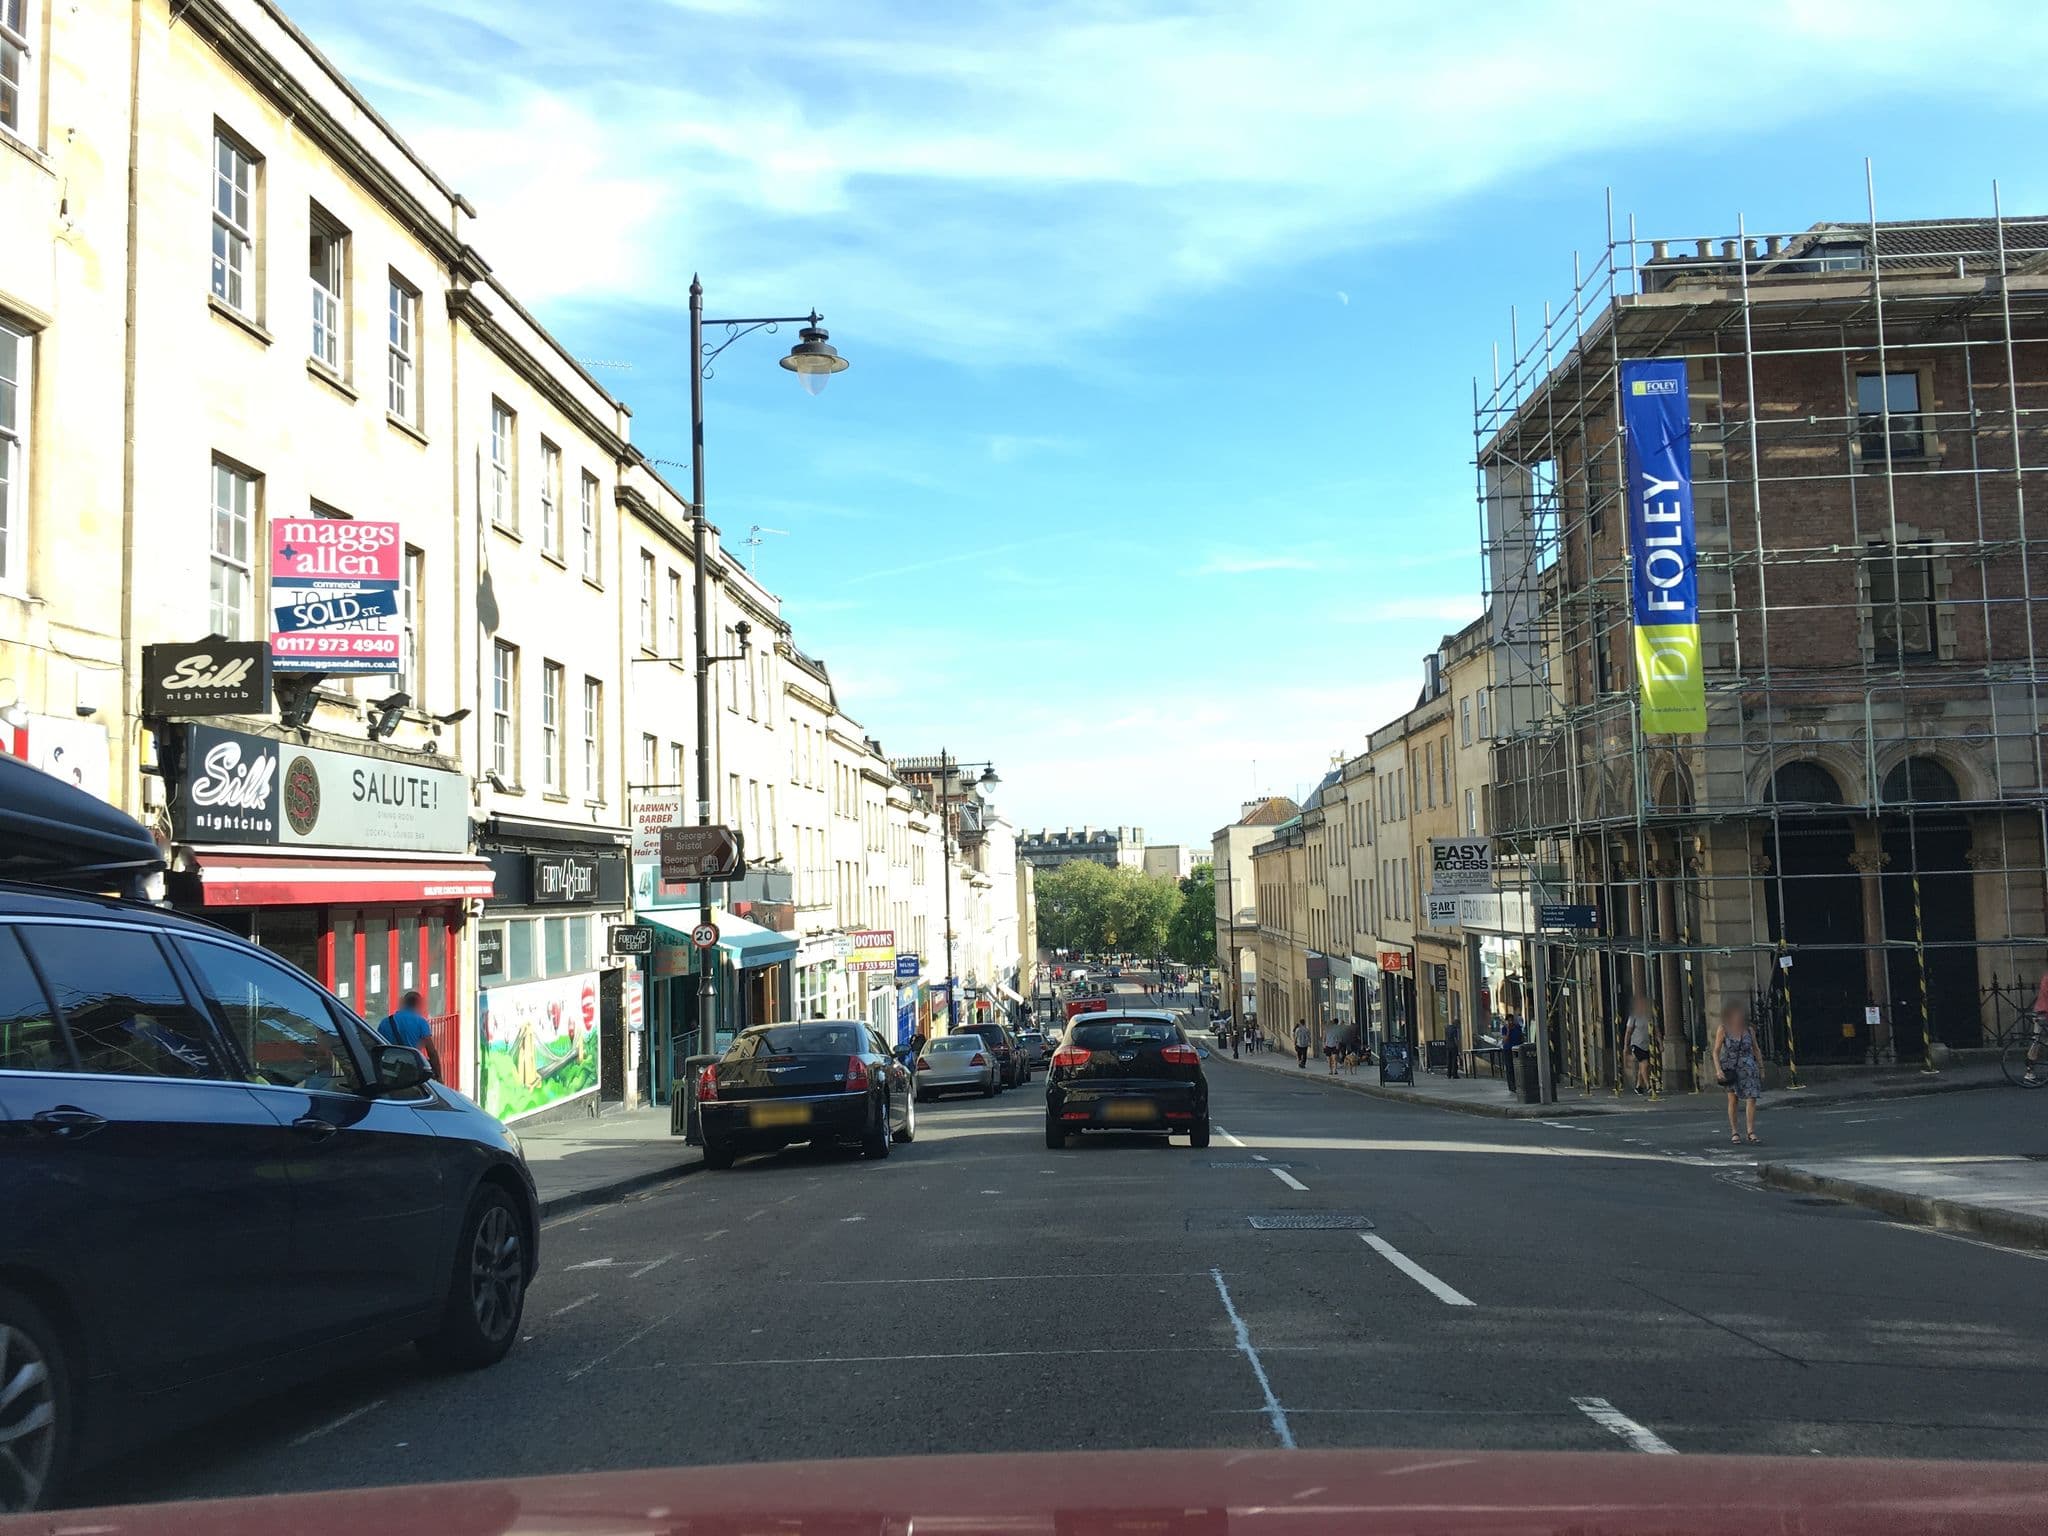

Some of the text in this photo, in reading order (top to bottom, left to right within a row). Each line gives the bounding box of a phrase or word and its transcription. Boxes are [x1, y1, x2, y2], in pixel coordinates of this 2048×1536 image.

[1647, 382, 1675, 390] FOLEY
[283, 522, 395, 552] maggs
[296, 547, 380, 575] allen
[1642, 472, 1694, 681] DJ FOLEY
[313, 581, 361, 589] commercial
[293, 598, 382, 628] SOLD STC
[276, 637, 395, 652] 0117 973 4940
[272, 659, 398, 670] www.maggsandallen.co.uk
[161, 654, 255, 690] Silk
[166, 691, 249, 701] nightclub
[191, 741, 277, 811] Silk
[352, 769, 438, 810] SALUTE!
[632, 802, 679, 813] KARWAN'S
[196, 813, 272, 832] nightclub
[638, 814, 673, 824] BARBER
[678, 830, 713, 842] George's
[643, 840, 660, 848] Gen
[675, 841, 703, 850] Bristol
[1433, 844, 1489, 861] EASY
[664, 855, 699, 866] Georgian
[1434, 860, 1489, 871] ACCESS
[669, 865, 690, 874] Hous
[1438, 901, 1456, 911] ART
[695, 930, 712, 942] 20
[854, 933, 893, 947] OOTONS
[848, 961, 895, 971] 0117 933 9915
